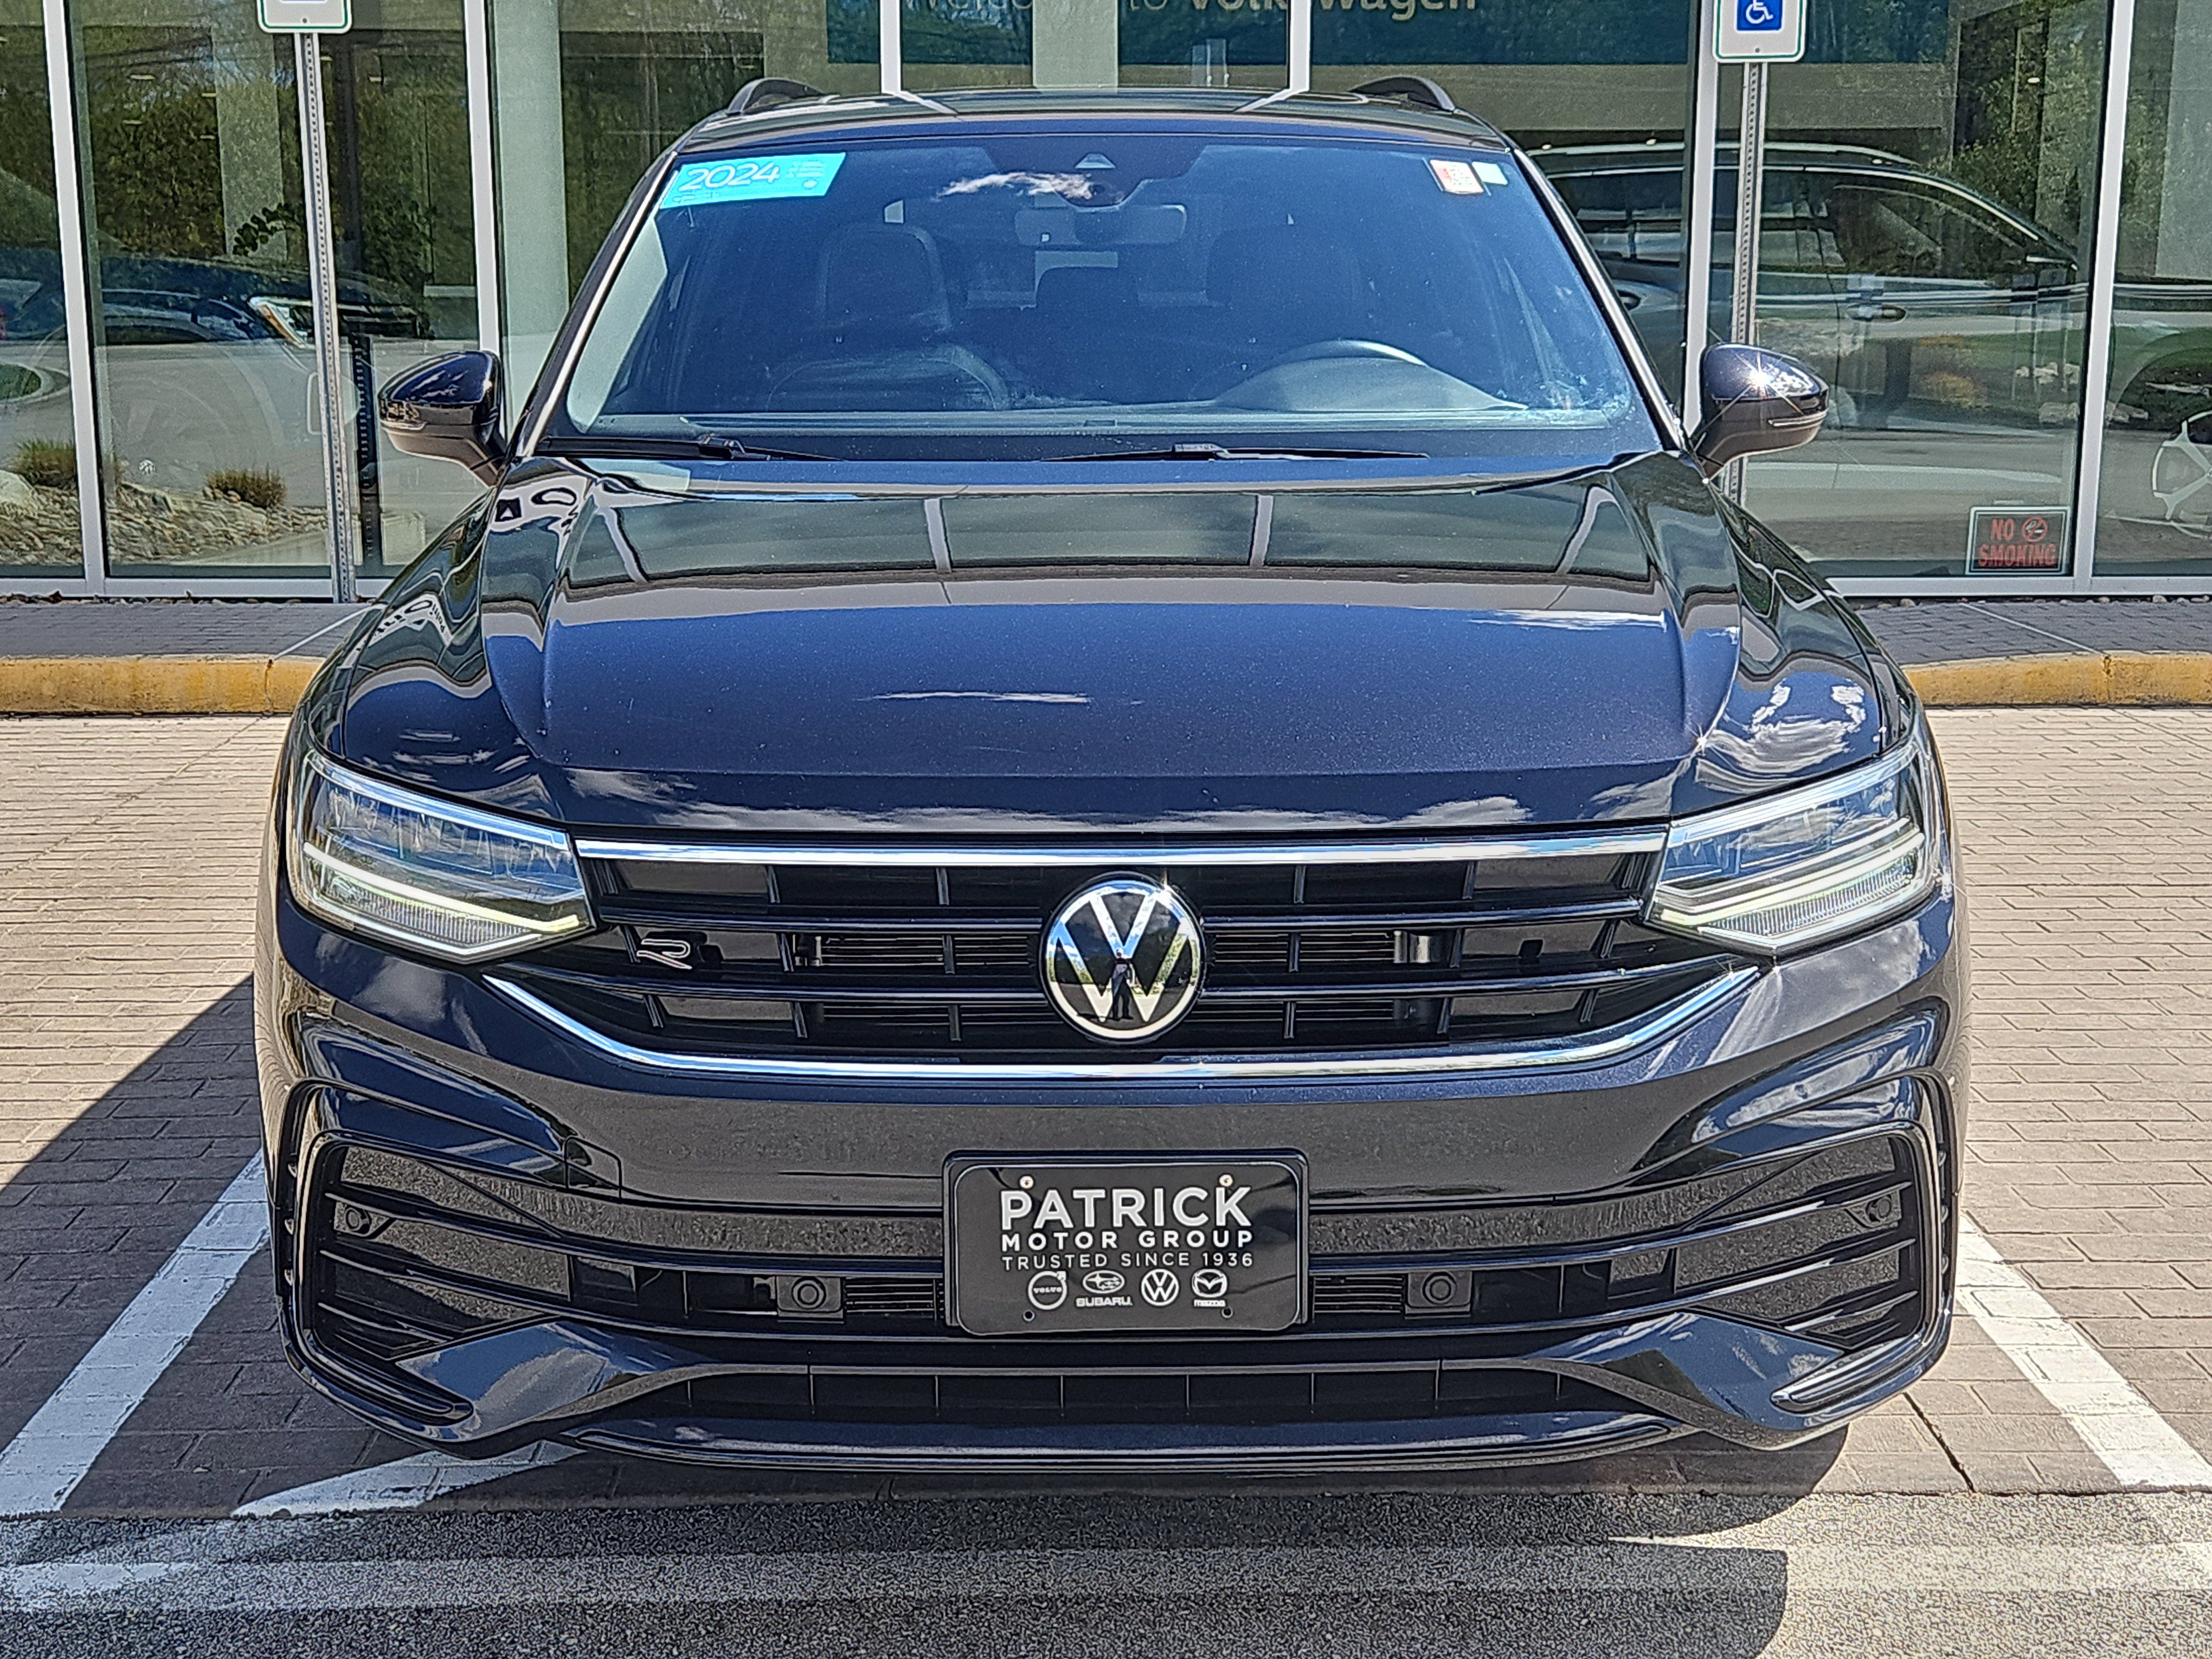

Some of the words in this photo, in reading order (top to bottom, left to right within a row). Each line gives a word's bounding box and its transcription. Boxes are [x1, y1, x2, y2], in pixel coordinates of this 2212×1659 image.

[678, 162, 780, 191] 2024
[1991, 518, 2015, 542] NO
[1979, 543, 2056, 567] SMOKING
[1001, 1186, 1252, 1230] PATRICK
[1002, 1231, 1118, 1252] MOTOR
[1138, 1230, 1253, 1249] GROUP
[1002, 1253, 1108, 1271] TRUSTED
[1121, 1252, 1190, 1267] SINCE
[1202, 1252, 1253, 1267] 1936
[1032, 1286, 1063, 1295] VOLVO
[1076, 1296, 1132, 1307] SUBARU
